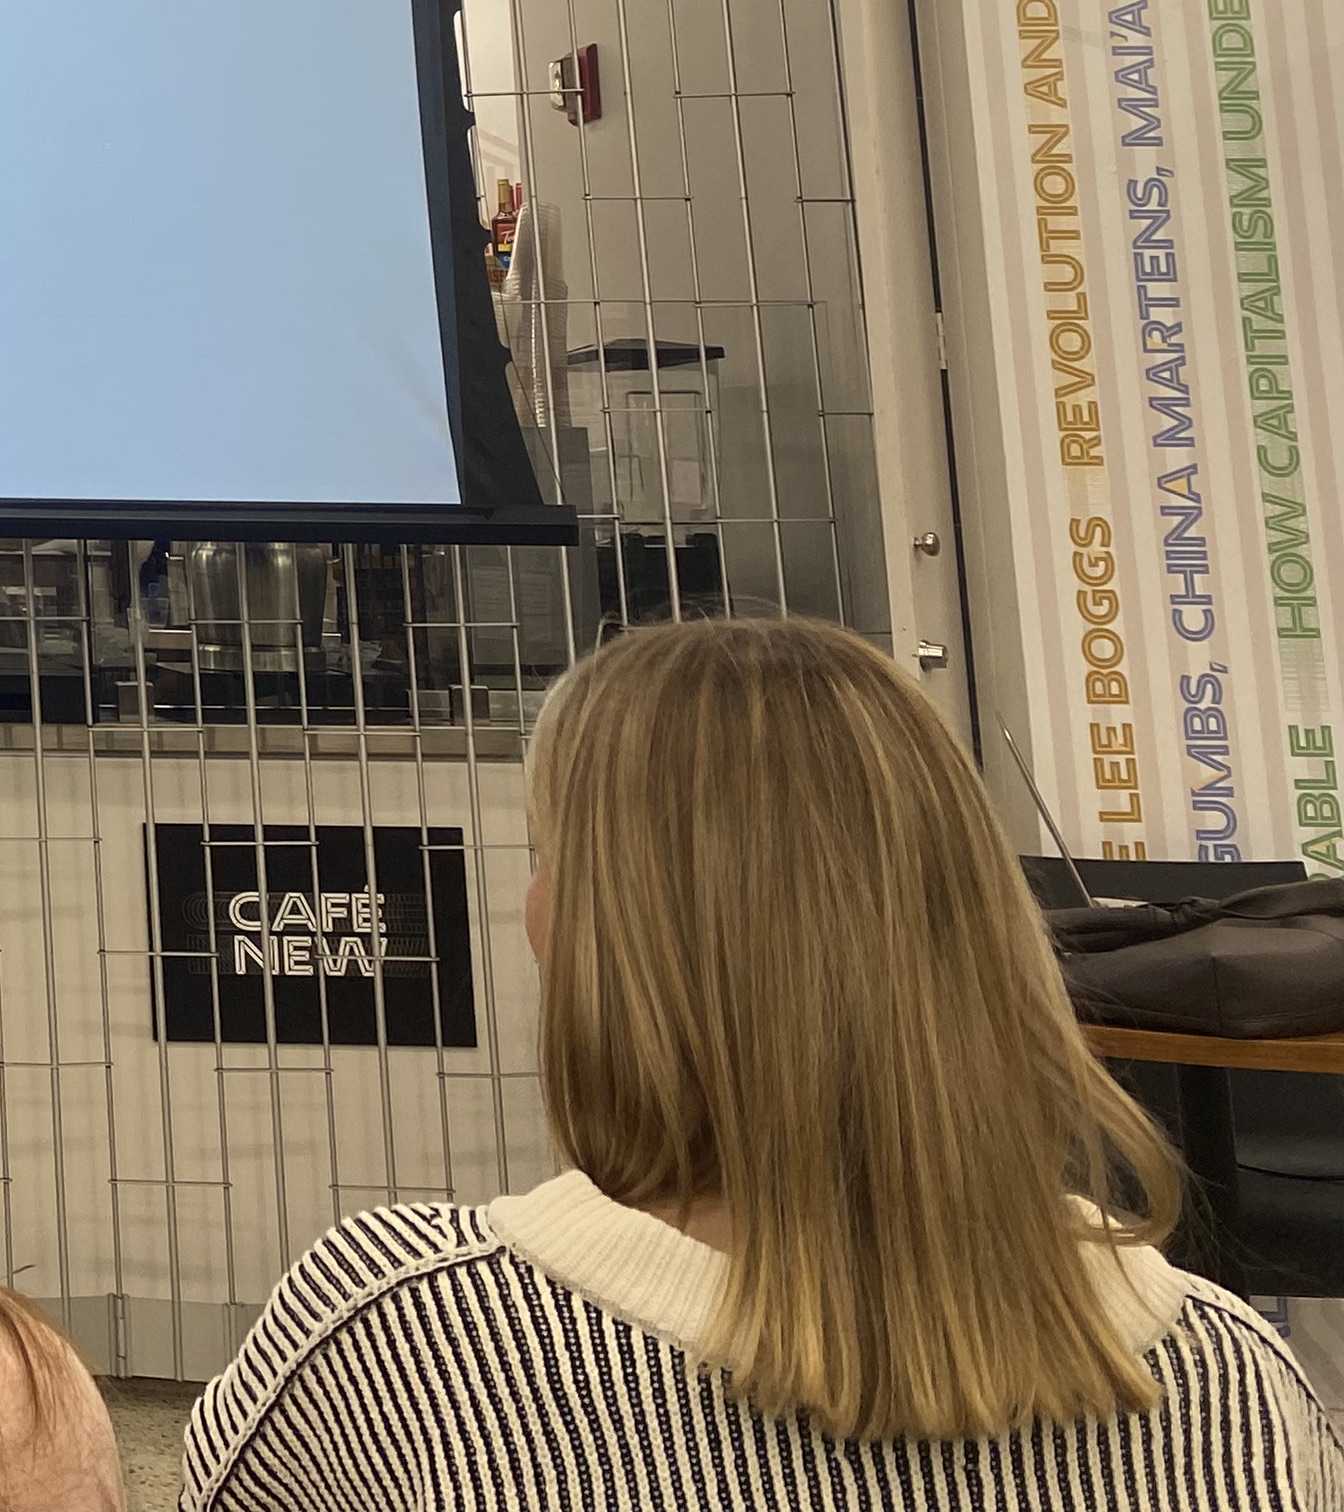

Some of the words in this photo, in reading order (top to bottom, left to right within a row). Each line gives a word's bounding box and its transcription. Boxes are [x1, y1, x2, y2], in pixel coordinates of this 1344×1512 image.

[1027, 123, 1105, 467] REVOLUTION
[1126, 165, 1196, 448] MARTENS,
[1225, 157, 1301, 478] CAPITALISM
[1069, 515, 1131, 706] BOGGS
[1157, 462, 1216, 643] CHINA
[1261, 491, 1321, 640] HOW
[1089, 721, 1143, 824] LEE
[1288, 724, 1344, 880] ABLE
[233, 934, 389, 977] NEW
